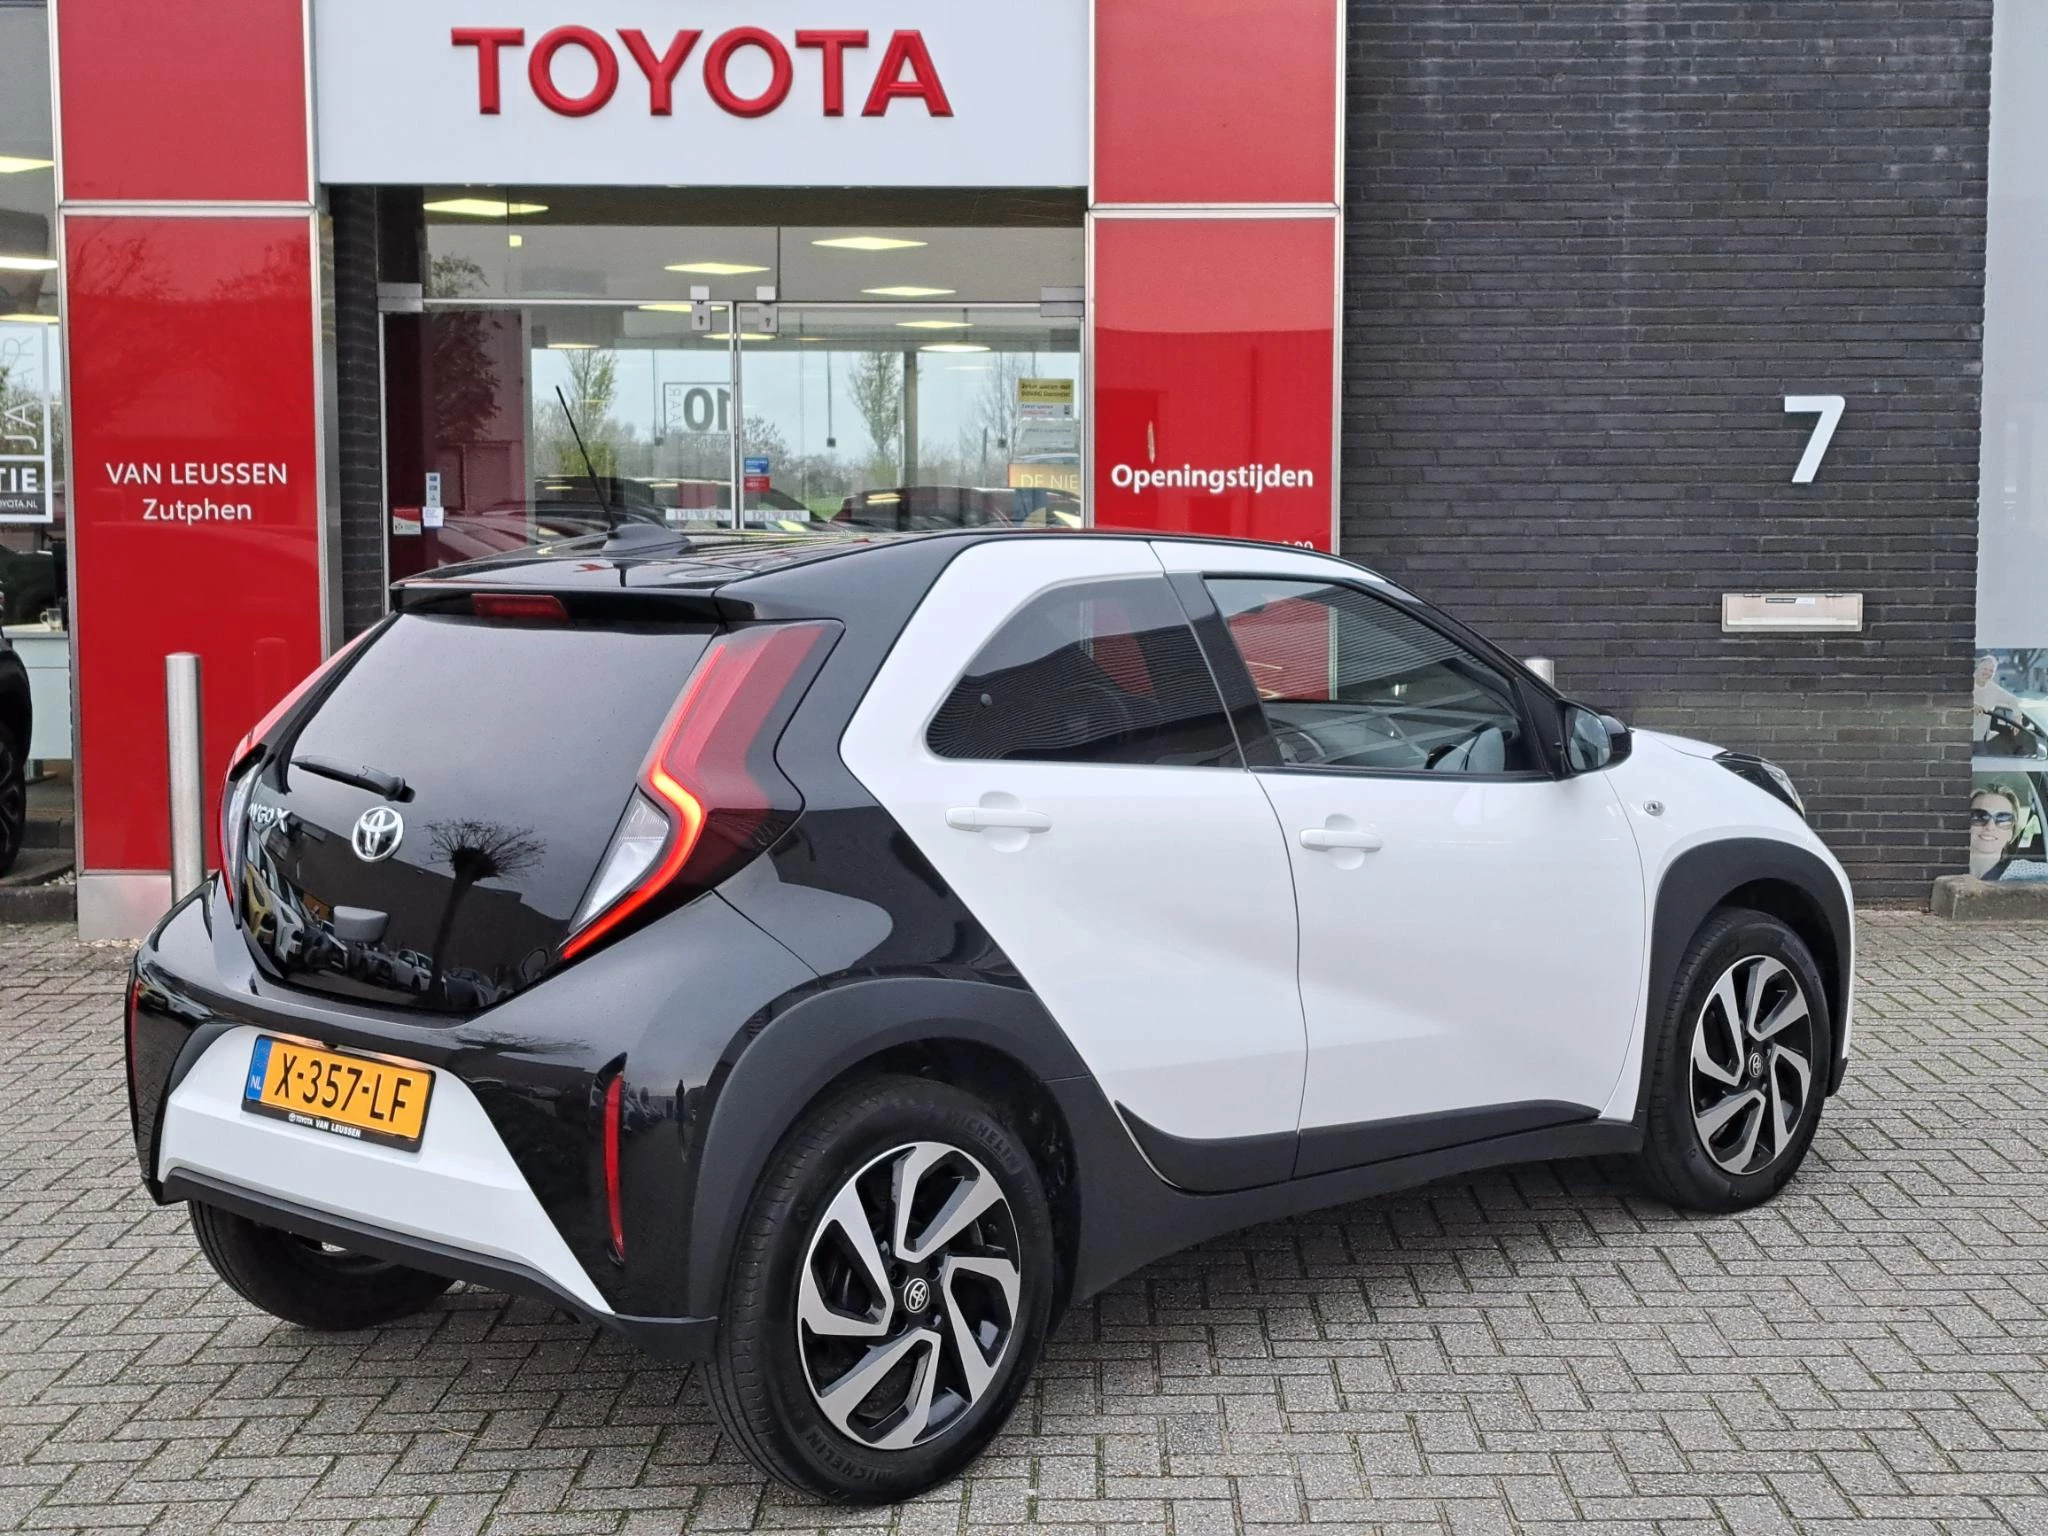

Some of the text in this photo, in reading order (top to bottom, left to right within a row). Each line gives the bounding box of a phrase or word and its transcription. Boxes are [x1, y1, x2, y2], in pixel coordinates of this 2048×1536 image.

[451, 25, 954, 117] TOYOTA
[1784, 396, 1845, 482] 7
[105, 462, 287, 485] VAN LEUSSEN
[1111, 464, 1313, 494] Openingstijden
[143, 498, 251, 525] Zutphen
[675, 510, 725, 520] DUWEN
[752, 511, 802, 521] DUWEN
[251, 1075, 262, 1091] NL
[274, 1053, 412, 1122] X-357-LF
[315, 1119, 329, 1130] VAN
[330, 1123, 362, 1138] LEUSSEN
